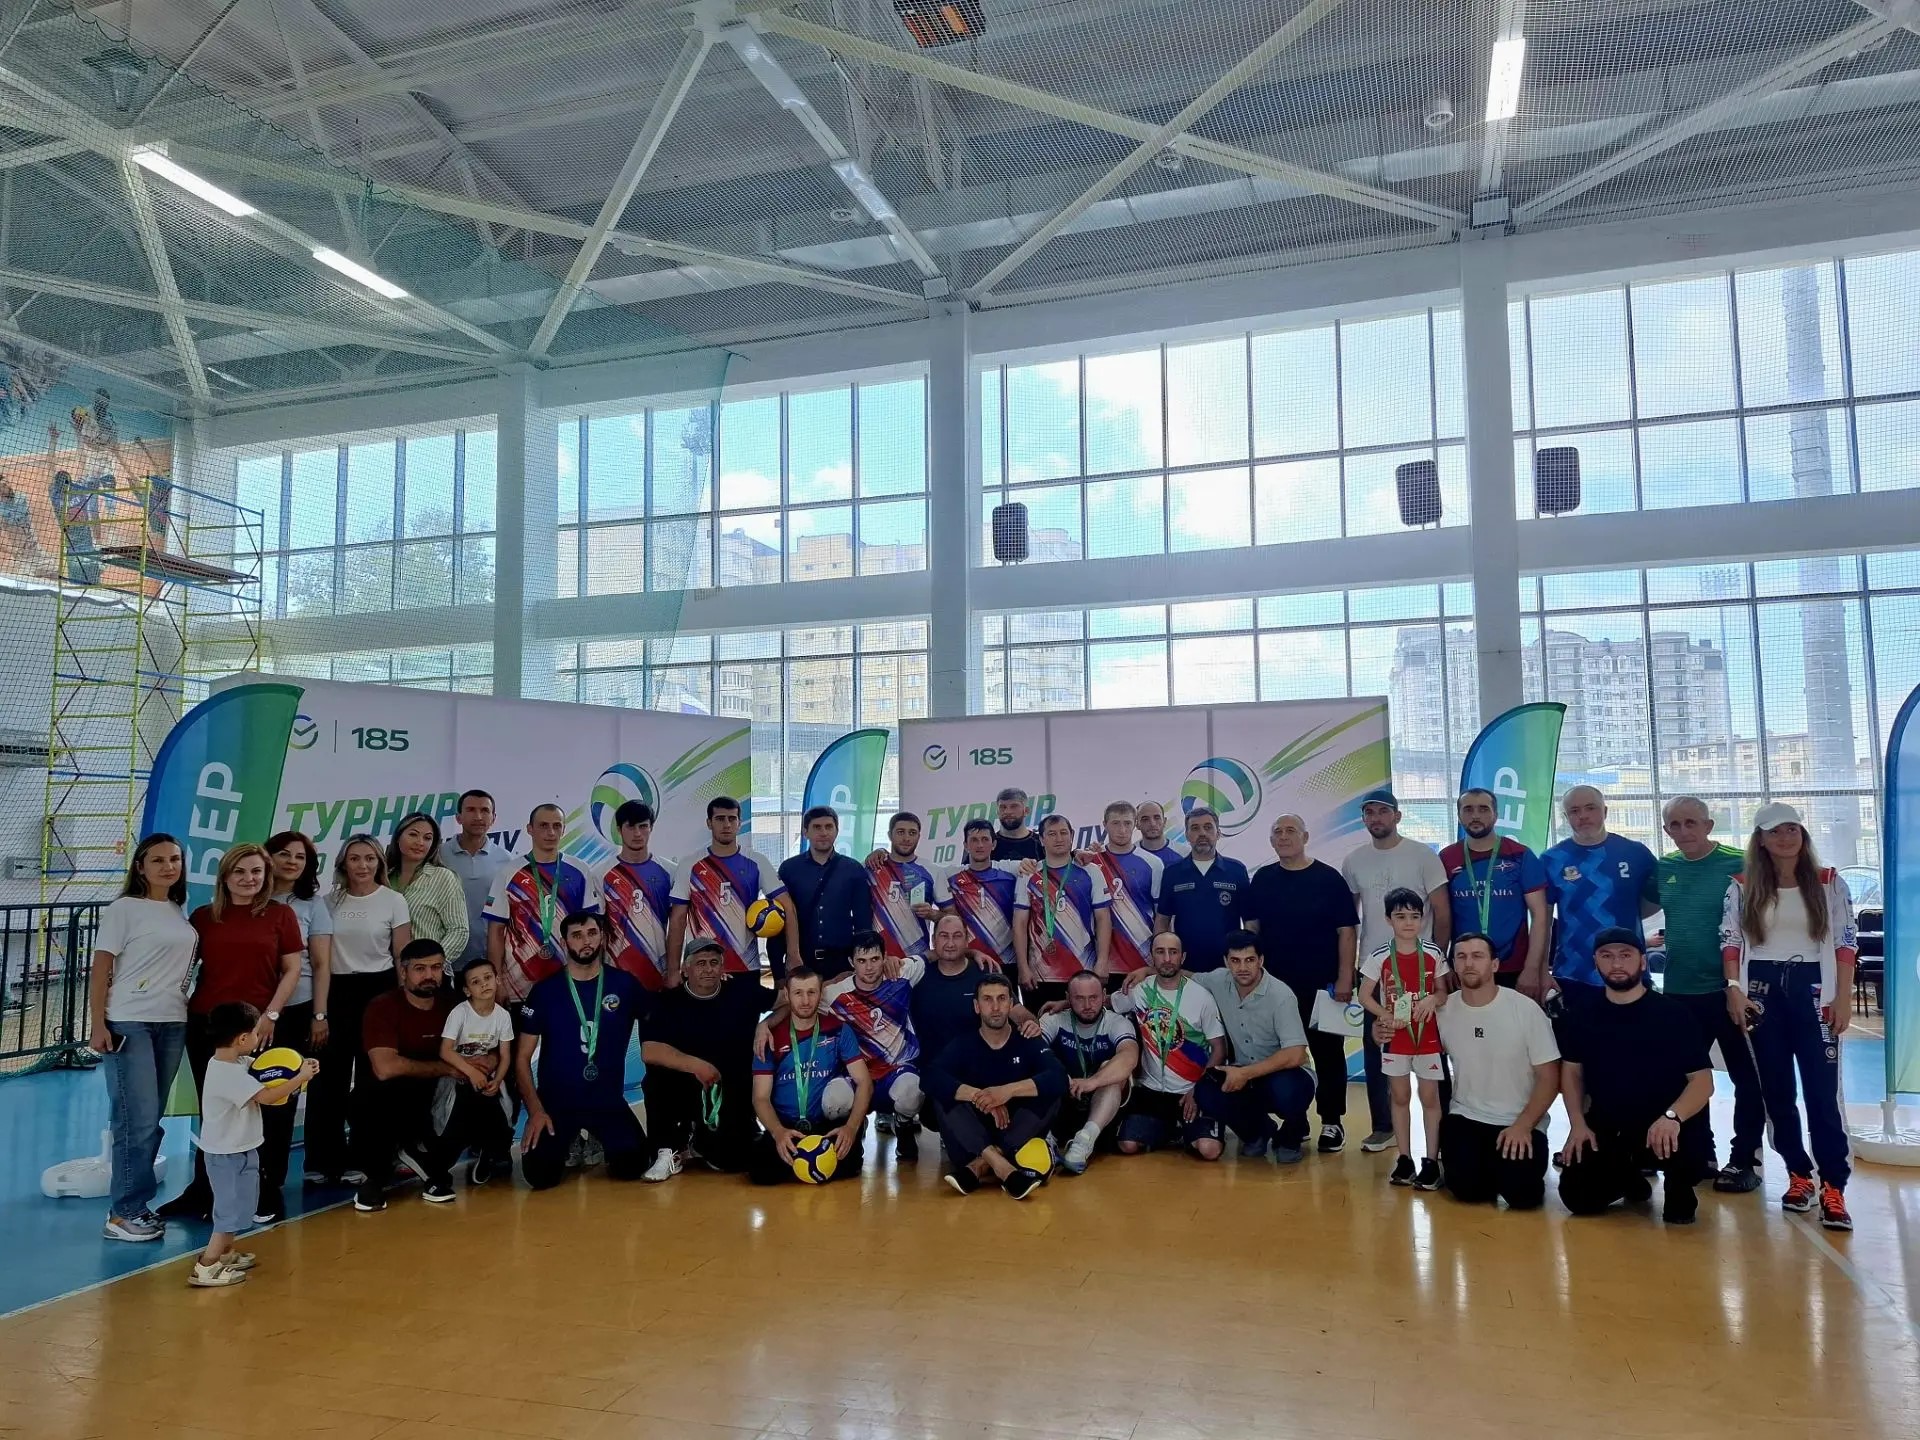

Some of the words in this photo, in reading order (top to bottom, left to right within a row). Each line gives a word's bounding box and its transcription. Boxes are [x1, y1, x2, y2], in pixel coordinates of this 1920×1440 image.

[351, 727, 410, 752] 185
[968, 747, 1014, 766] 185
[927, 794, 1057, 841] ТУРР
[183, 761, 243, 900] БЕР
[933, 844, 956, 864] ПО
[1618, 861, 1630, 878] 2
[632, 888, 644, 914] 3
[719, 881, 731, 906] 5
[888, 880, 901, 903] 5
[977, 887, 987, 909] 1
[1111, 877, 1124, 901] 2
[340, 911, 369, 920] BOSS
[869, 1007, 886, 1032] 2
